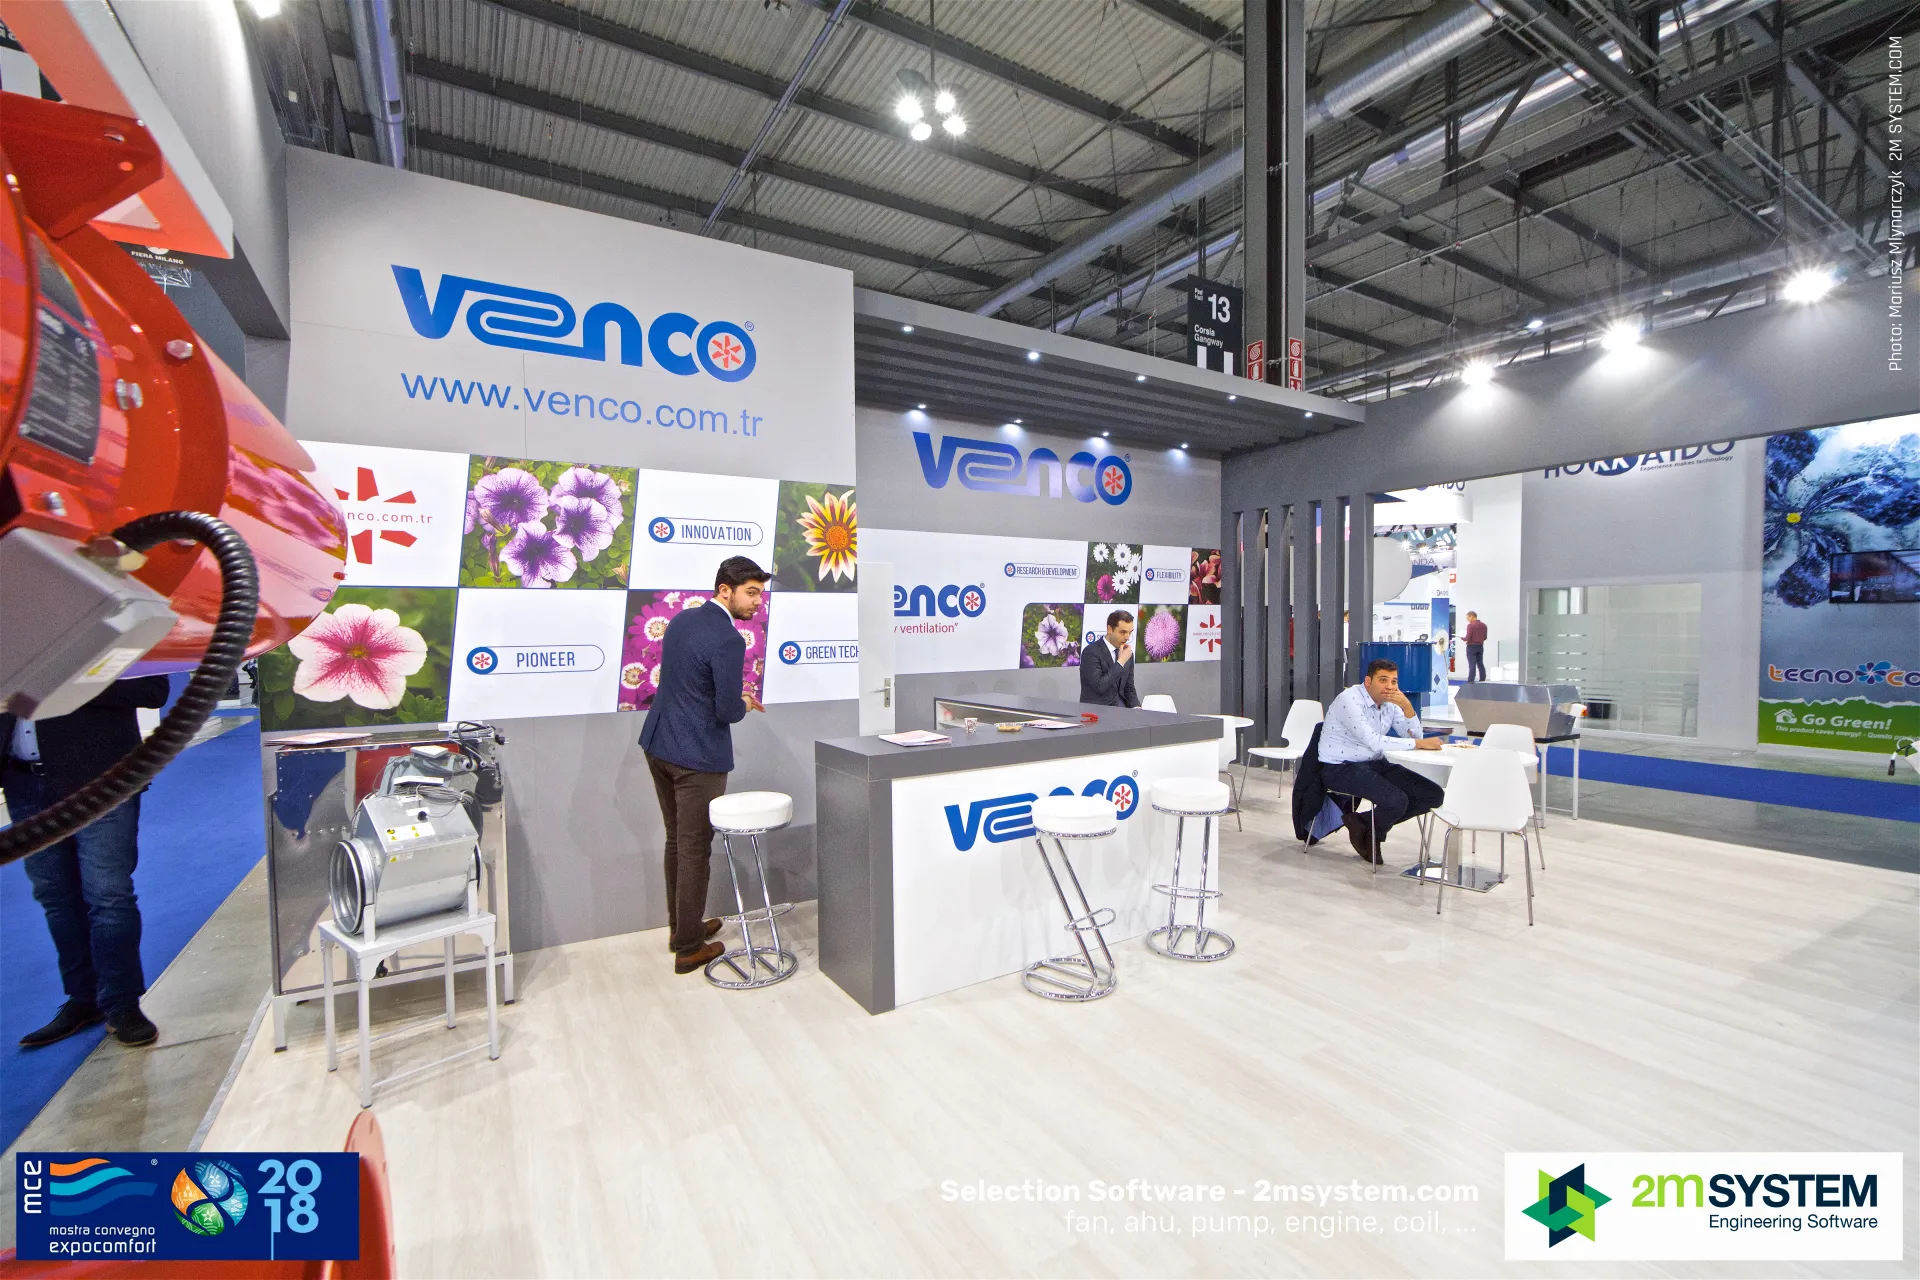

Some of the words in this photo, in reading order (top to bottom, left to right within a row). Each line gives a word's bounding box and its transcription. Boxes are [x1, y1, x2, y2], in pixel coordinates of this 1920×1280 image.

[131, 250, 153, 259] FIERA
[154, 255, 184, 264] MILANO
[1208, 294, 1231, 323] 13
[1194, 324, 1216, 337] Corsia
[1194, 333, 1223, 349] Gangway
[400, 372, 764, 437] www.venco.com.tr
[347, 512, 433, 524] nco.com.tr
[681, 524, 752, 542] INNOVATION
[1016, 566, 1041, 576] RESEARCH
[1046, 567, 1078, 577] DEVELOPMENT
[1156, 571, 1182, 580] FLEXIBILITY
[516, 651, 576, 668] PIONEER
[805, 646, 837, 660] GREEN
[1801, 713, 1827, 726] Go
[1830, 715, 1893, 730] Green!
[1867, 732, 1893, 740] Questo
